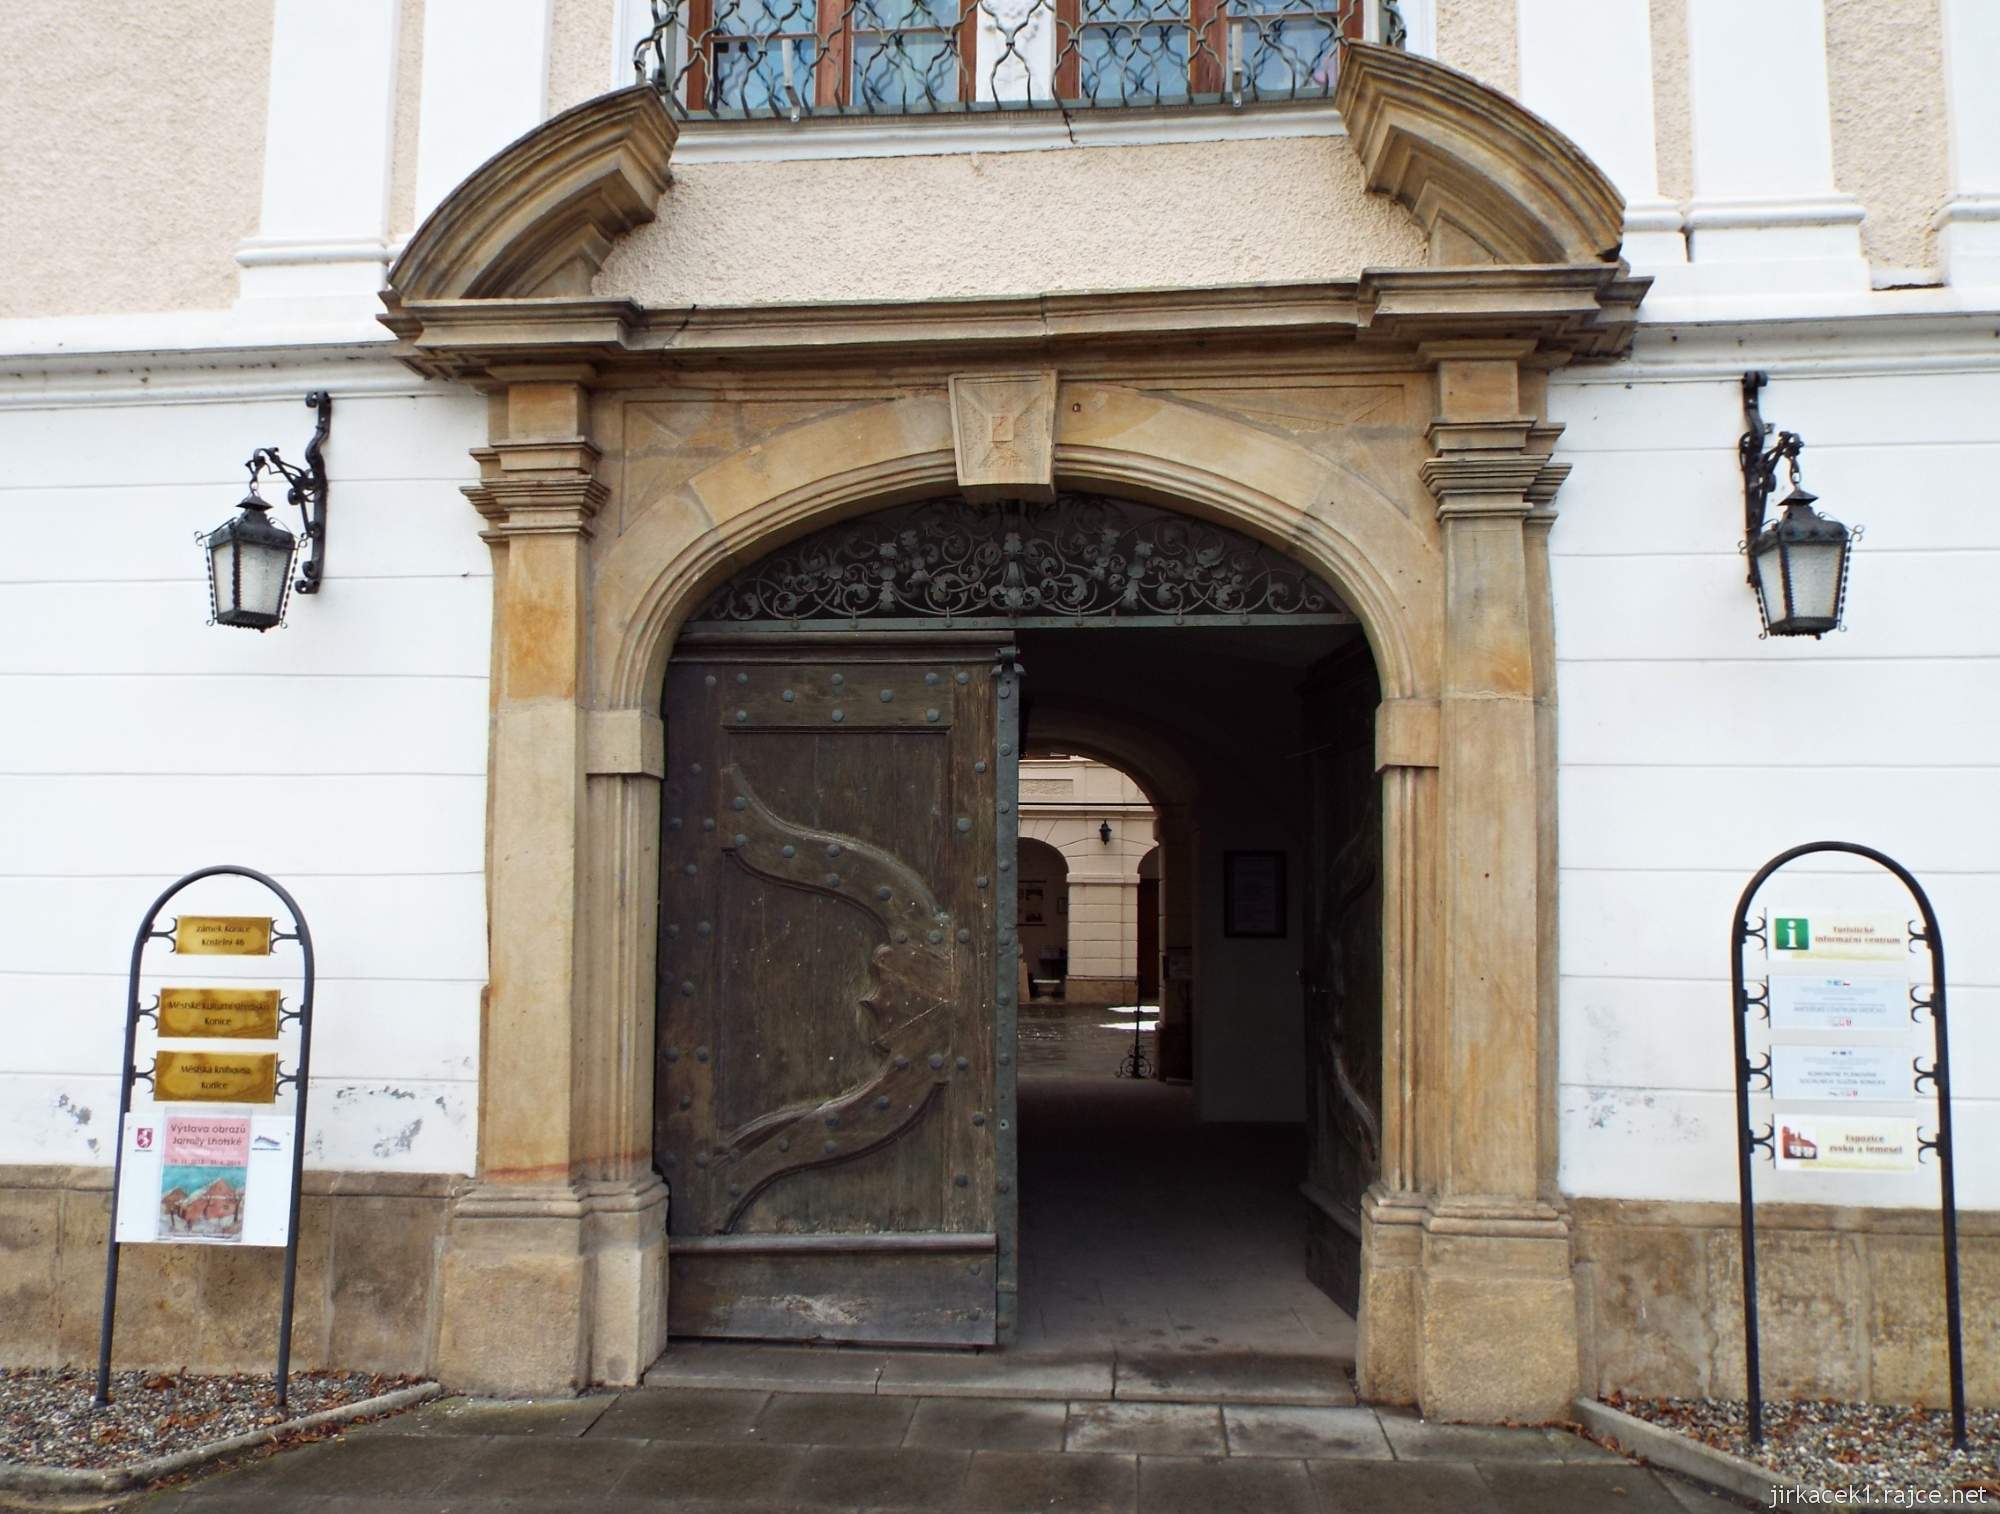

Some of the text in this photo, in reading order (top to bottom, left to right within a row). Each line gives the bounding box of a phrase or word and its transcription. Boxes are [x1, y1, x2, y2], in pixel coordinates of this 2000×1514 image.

[170, 1122, 246, 1134] Výstava obrazů
[207, 1136, 242, 1146] Lhotské
